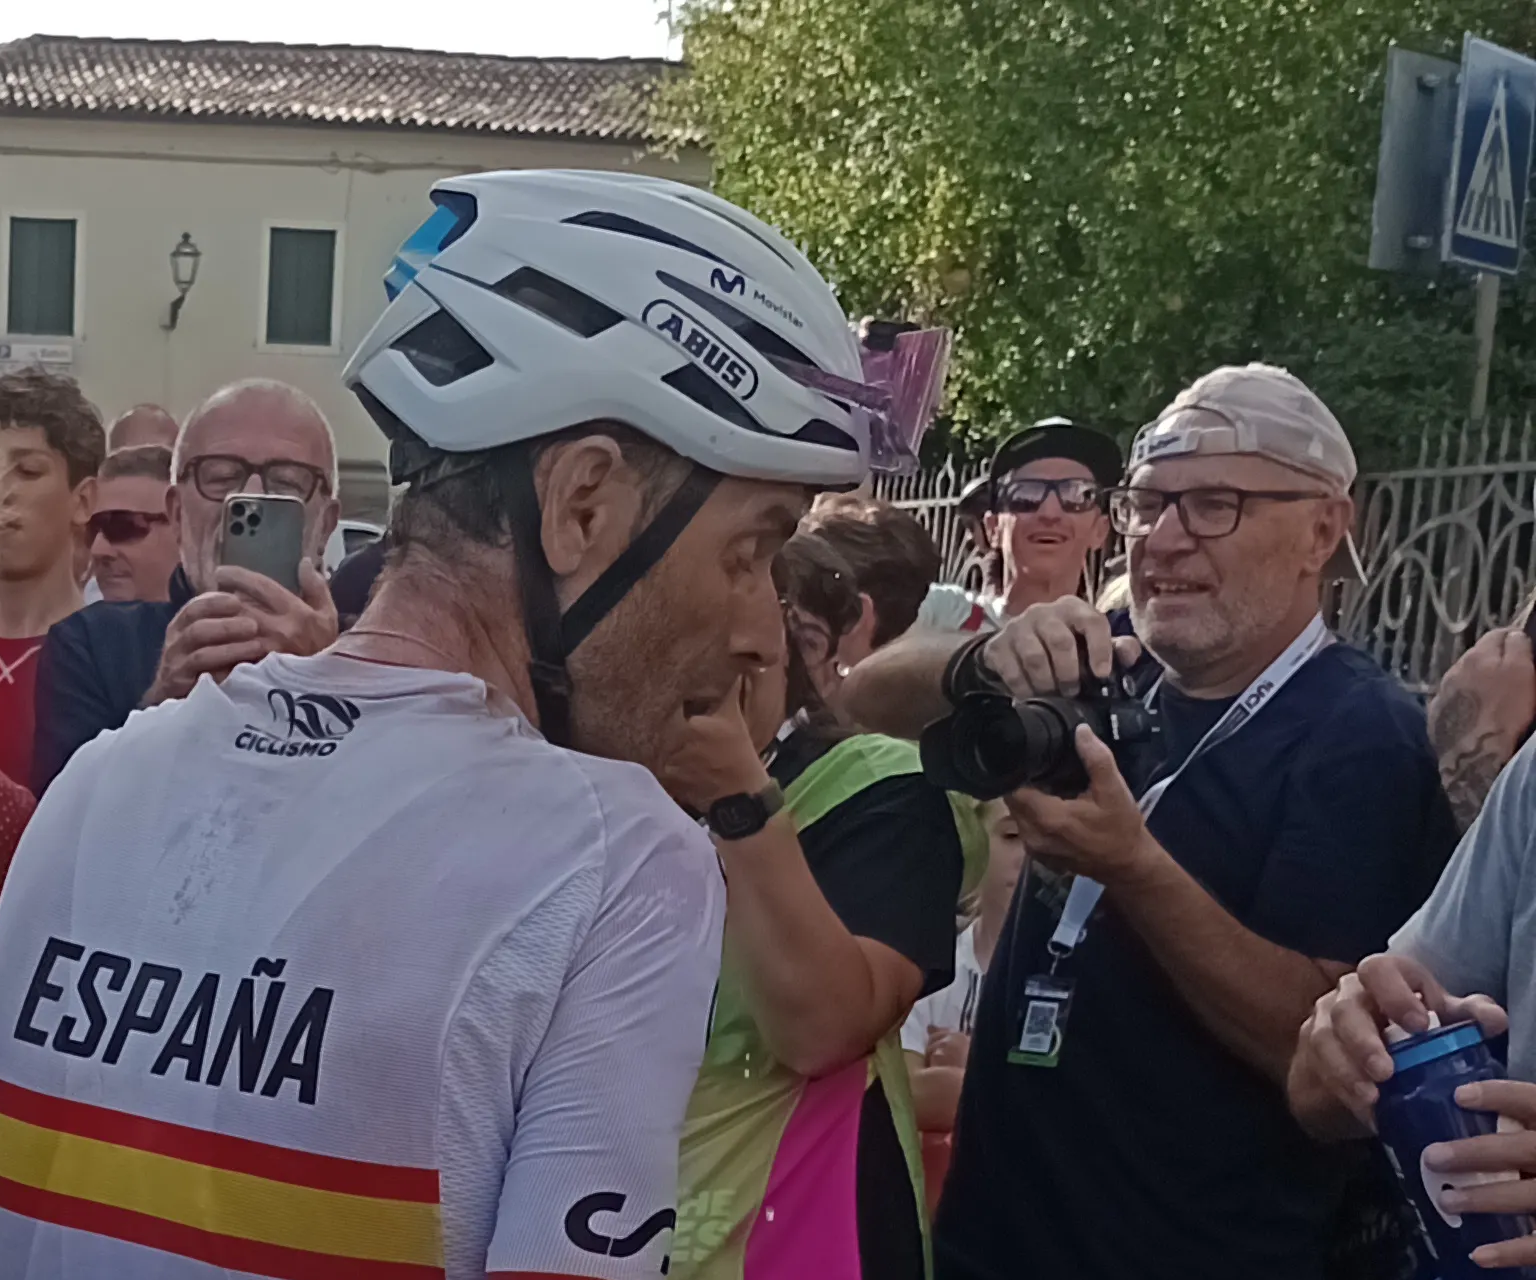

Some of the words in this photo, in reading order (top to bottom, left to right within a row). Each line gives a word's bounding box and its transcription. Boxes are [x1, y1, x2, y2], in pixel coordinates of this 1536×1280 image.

[753, 290, 804, 329] Movistar
[657, 313, 747, 389] ABUS
[234, 731, 338, 757] CICLISMO
[14, 936, 334, 1106] ESPAÑA
